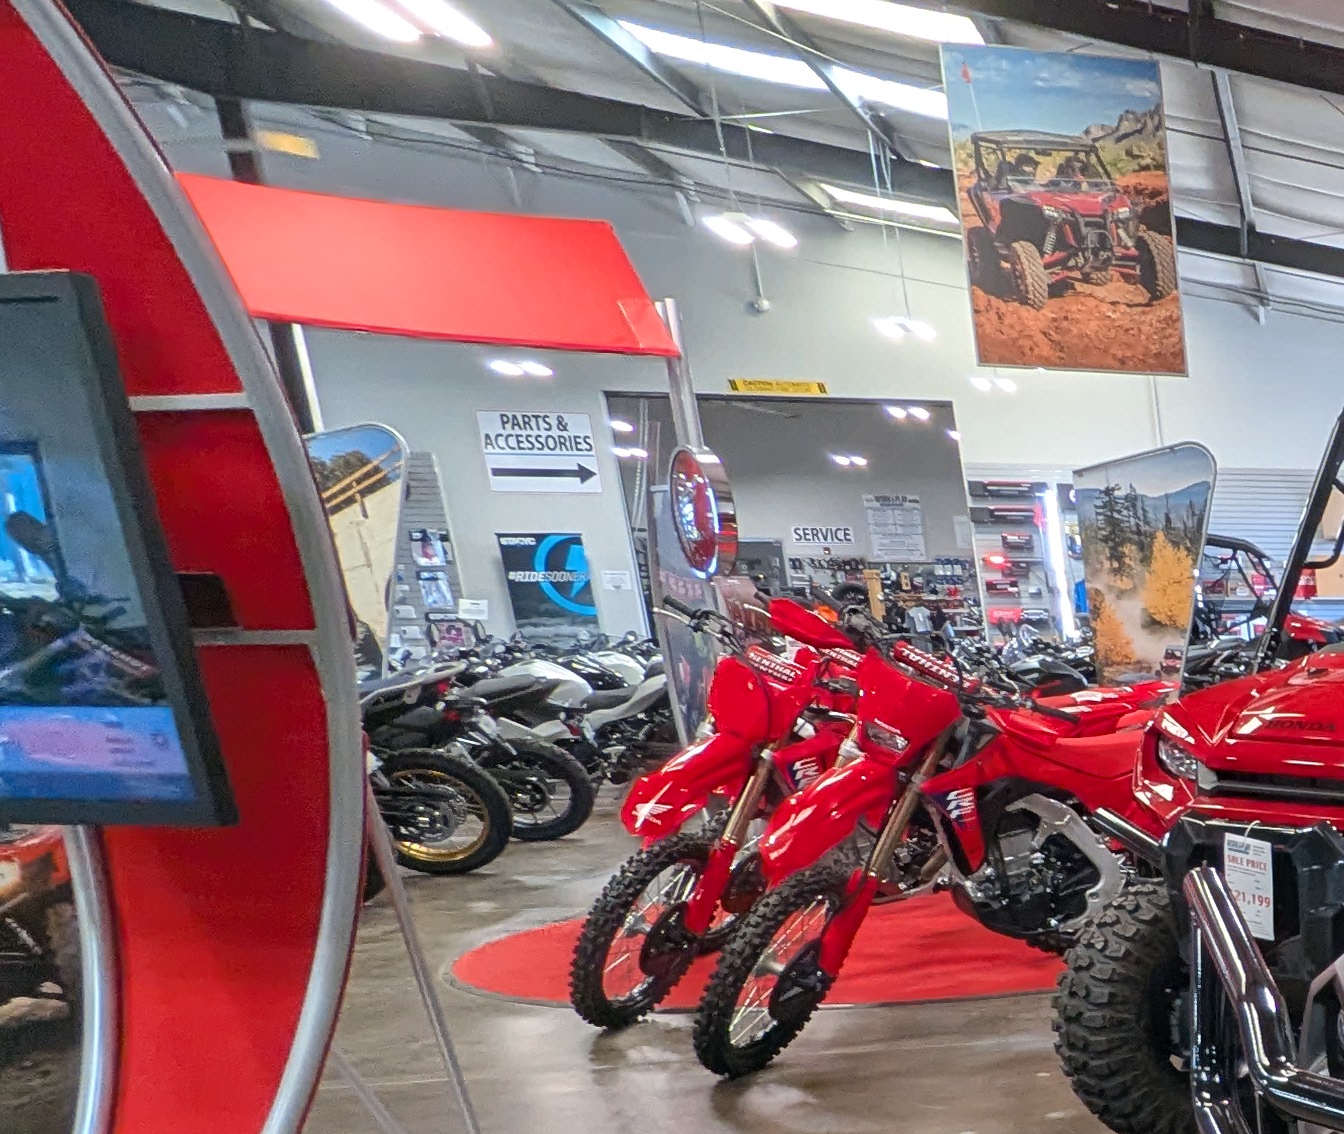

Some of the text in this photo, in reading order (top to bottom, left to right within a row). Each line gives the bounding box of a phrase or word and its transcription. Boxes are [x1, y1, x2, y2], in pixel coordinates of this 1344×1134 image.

[500, 413, 568, 432] PARTS &
[484, 433, 593, 452] ACCESSORIES
[793, 527, 851, 542] SERVICE
[1266, 719, 1336, 733] HONDA
[1231, 889, 1271, 908] 21,199
